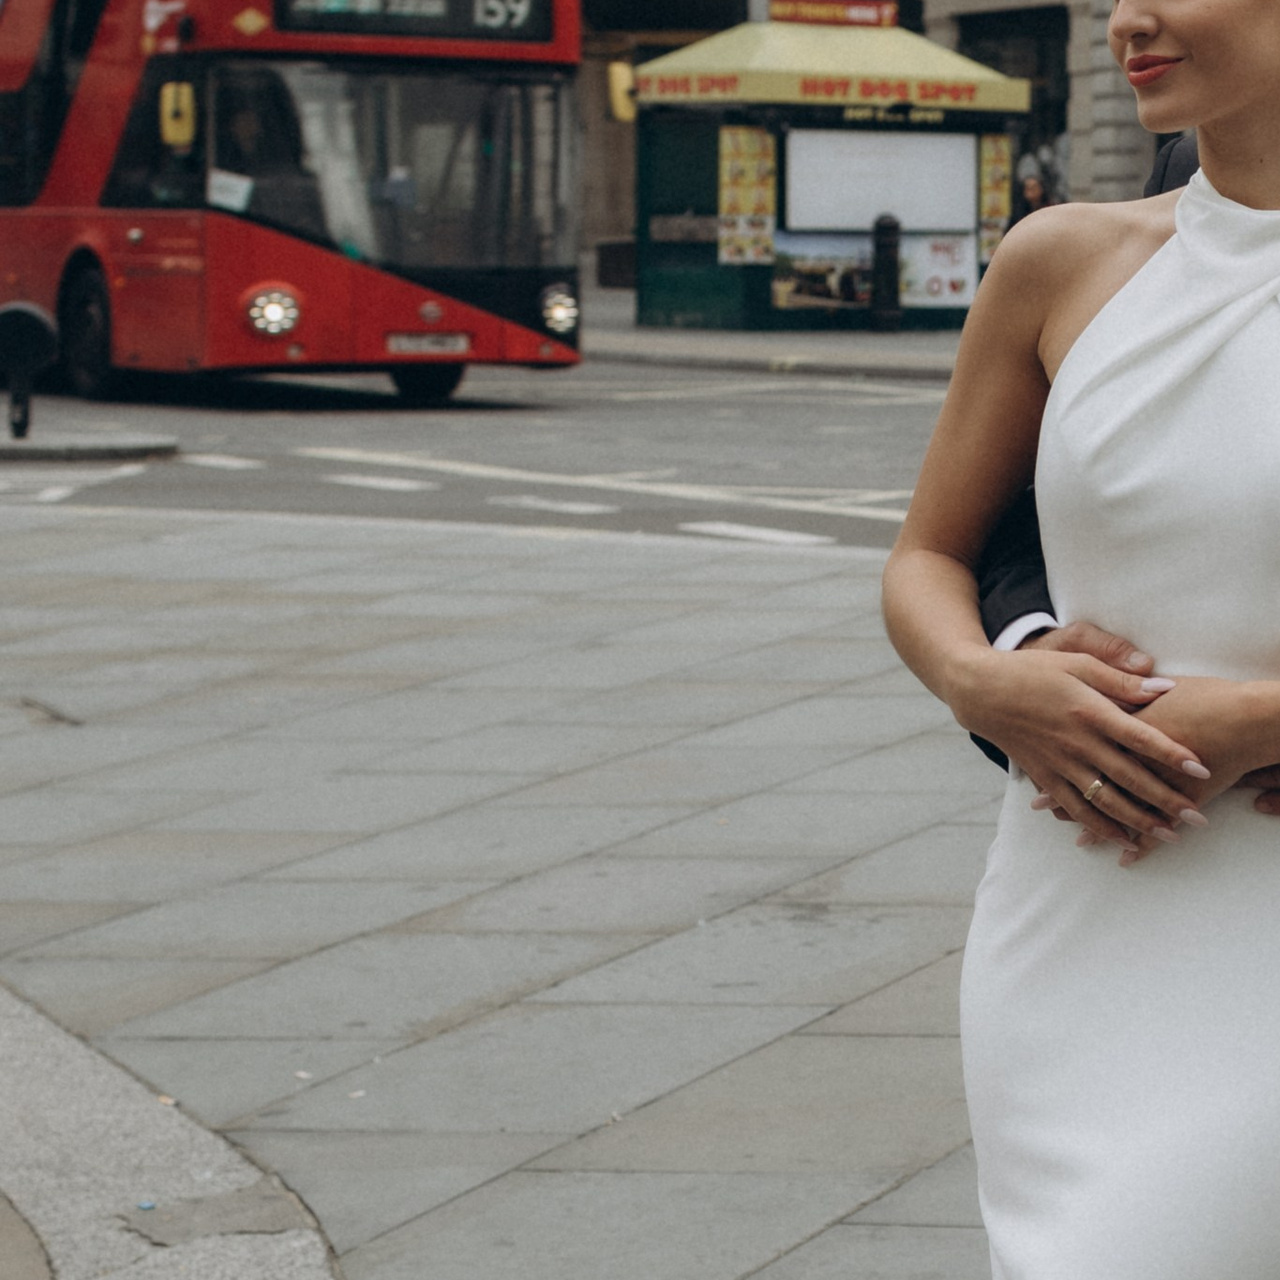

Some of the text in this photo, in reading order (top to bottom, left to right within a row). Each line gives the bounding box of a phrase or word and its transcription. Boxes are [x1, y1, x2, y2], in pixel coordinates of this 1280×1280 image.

[801, 78, 977, 101] HOT DOG SPOT
